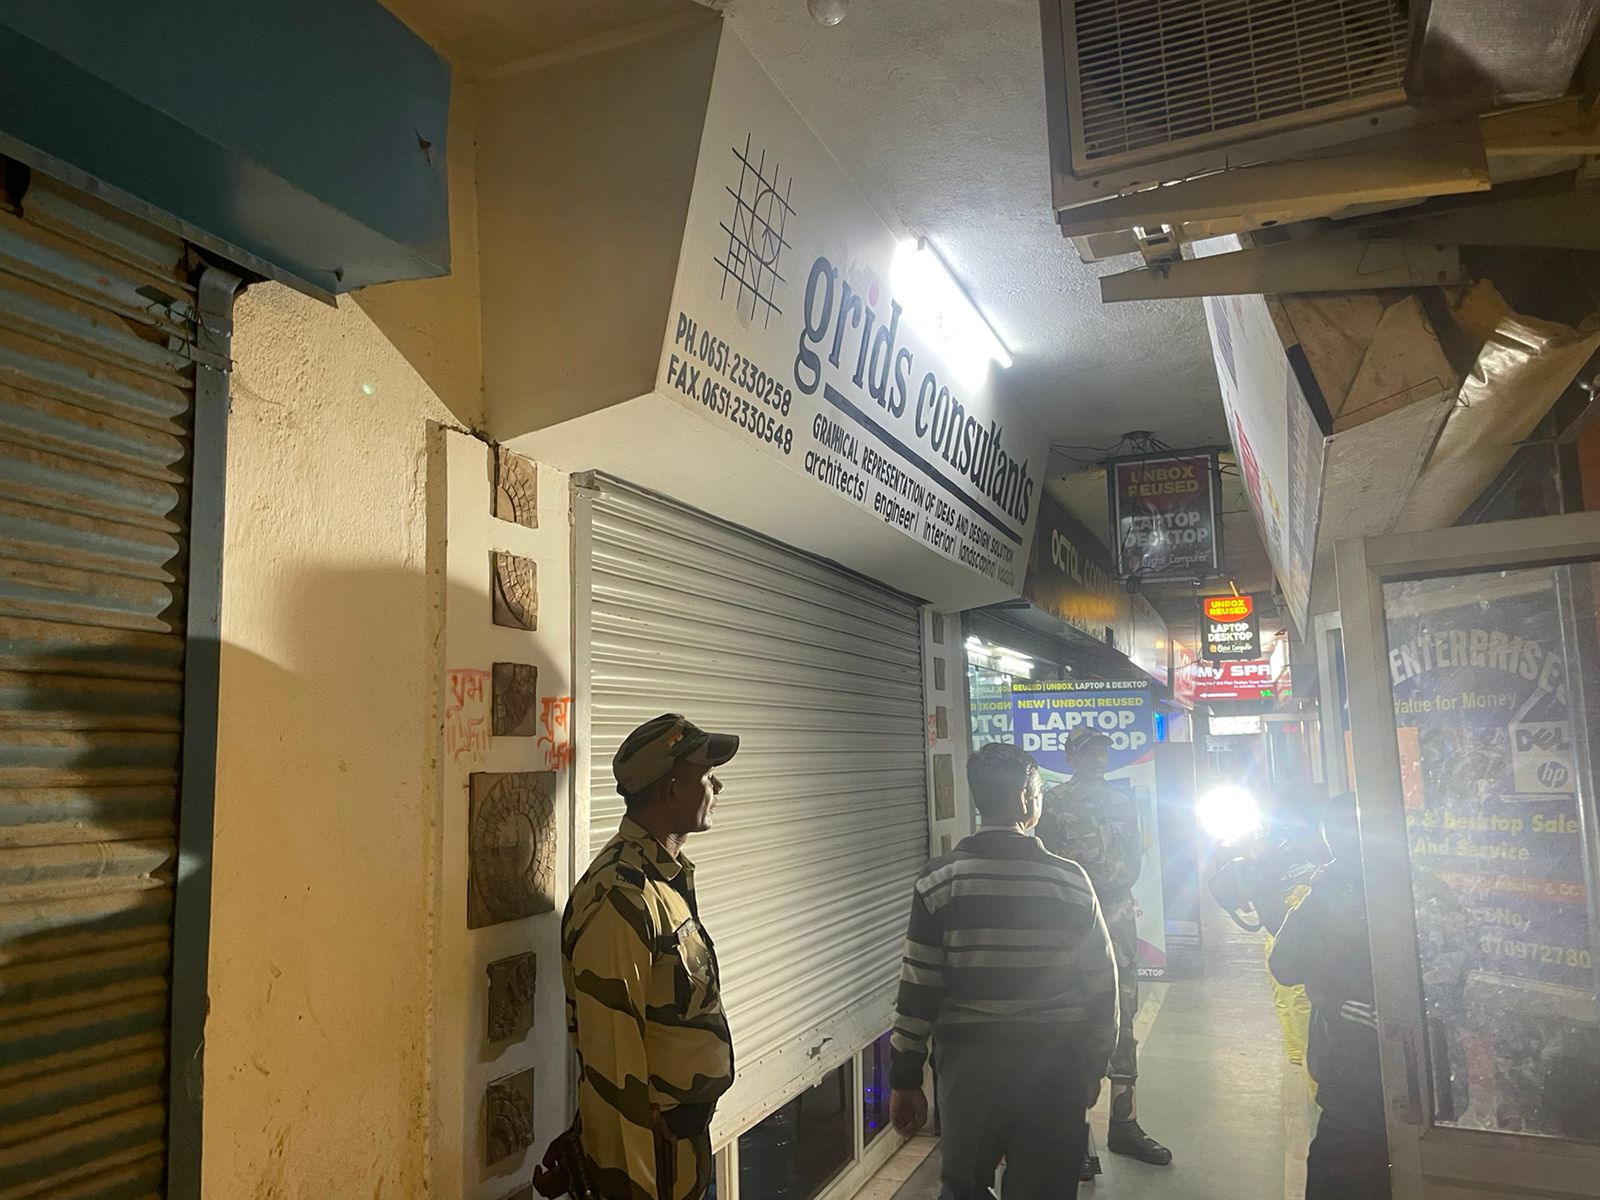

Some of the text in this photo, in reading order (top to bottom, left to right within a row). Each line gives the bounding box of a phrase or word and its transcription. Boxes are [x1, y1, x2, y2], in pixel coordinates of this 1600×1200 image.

[794, 256, 1033, 526] grids consultants
[1130, 466, 1195, 483] UNBOX
[1128, 480, 1199, 497] REUSED
[861, 446, 925, 508] REPRESENTATION
[925, 492, 936, 513] OF
[935, 498, 956, 527] IDEAS
[955, 513, 969, 536] AND
[969, 522, 991, 550] DESIGN
[1209, 606, 1248, 616] REUSED
[1211, 599, 1245, 608] UNBOX
[1210, 622, 1249, 634] LAPTOP
[1207, 632, 1254, 642] DESKTOP
[1197, 667, 1224, 679] My
[1075, 682, 1105, 690] LAPTOP
[1112, 680, 1147, 689] DESKTOP
[1018, 699, 1046, 710] NEW
[1098, 697, 1144, 707] REUSED
[1435, 694, 1457, 711] for
[1461, 691, 1517, 714] Money
[1031, 710, 1136, 731] LAPTOP
[1022, 731, 1147, 751] DESOP
[1532, 813, 1578, 833] Sale
[1414, 839, 1530, 861] And Service
